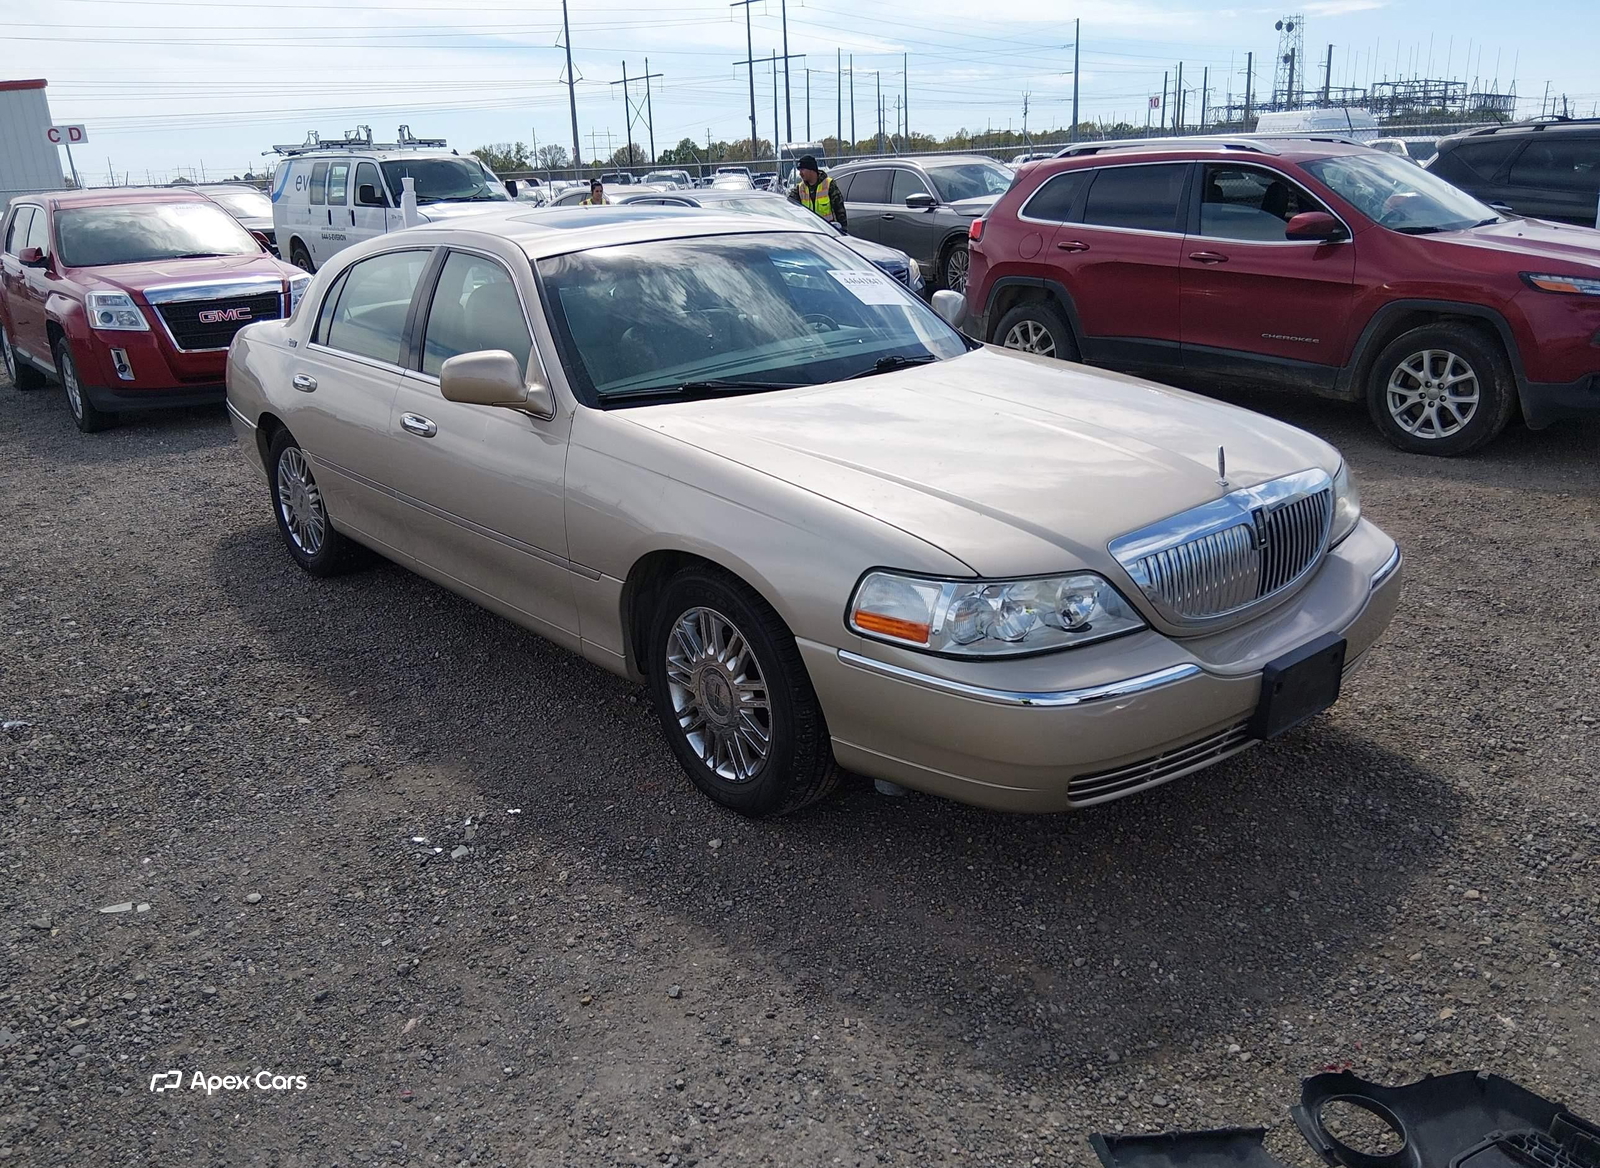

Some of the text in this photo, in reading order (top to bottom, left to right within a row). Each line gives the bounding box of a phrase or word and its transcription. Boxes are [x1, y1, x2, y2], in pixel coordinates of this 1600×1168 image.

[1149, 97, 1160, 108] 10
[47, 127, 82, 143] C D
[199, 306, 252, 324] GMC
[1261, 333, 1320, 344] CHEROKEE
